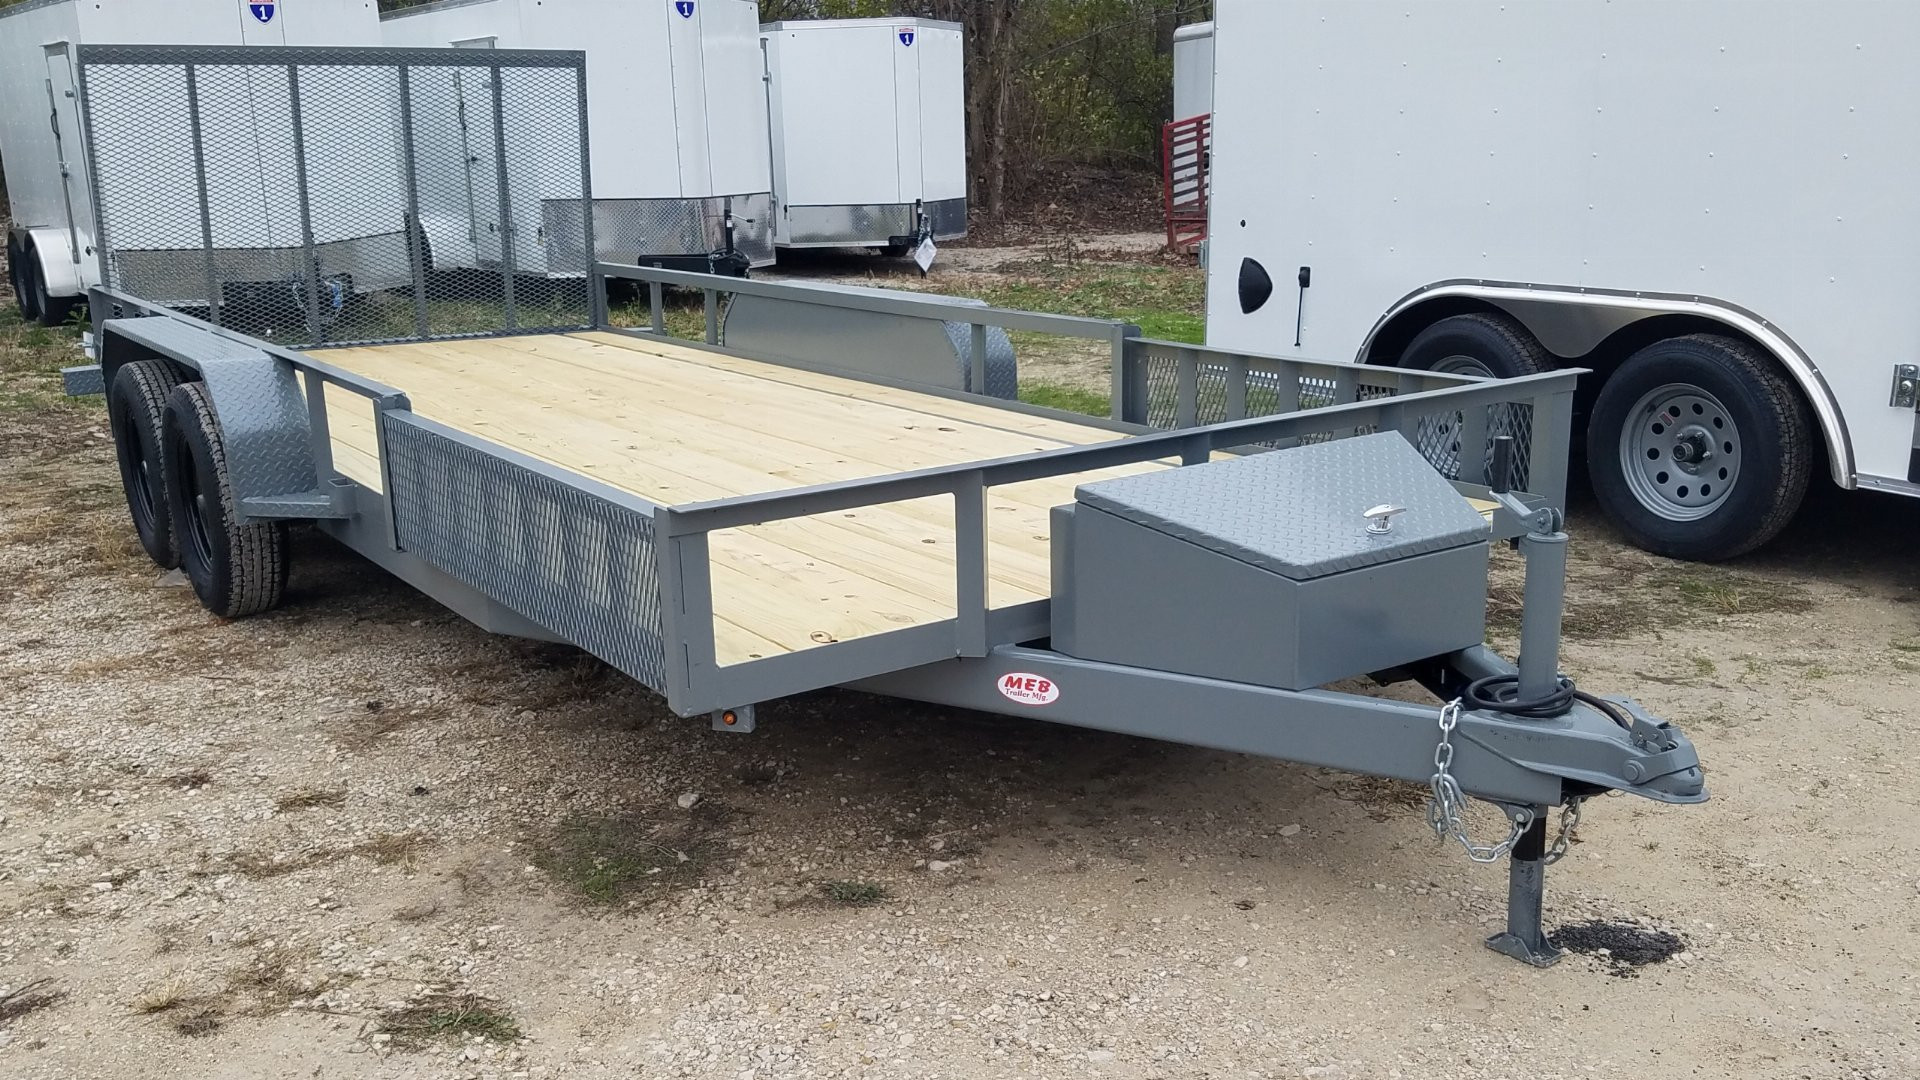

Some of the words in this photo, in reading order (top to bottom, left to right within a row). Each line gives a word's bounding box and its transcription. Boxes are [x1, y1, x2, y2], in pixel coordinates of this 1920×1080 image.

[260, 5, 268, 20] 1
[683, 3, 689, 15] 1
[904, 34, 910, 44] 1
[1005, 676, 1050, 692] MEB
[1005, 688, 1030, 698] Trailer
